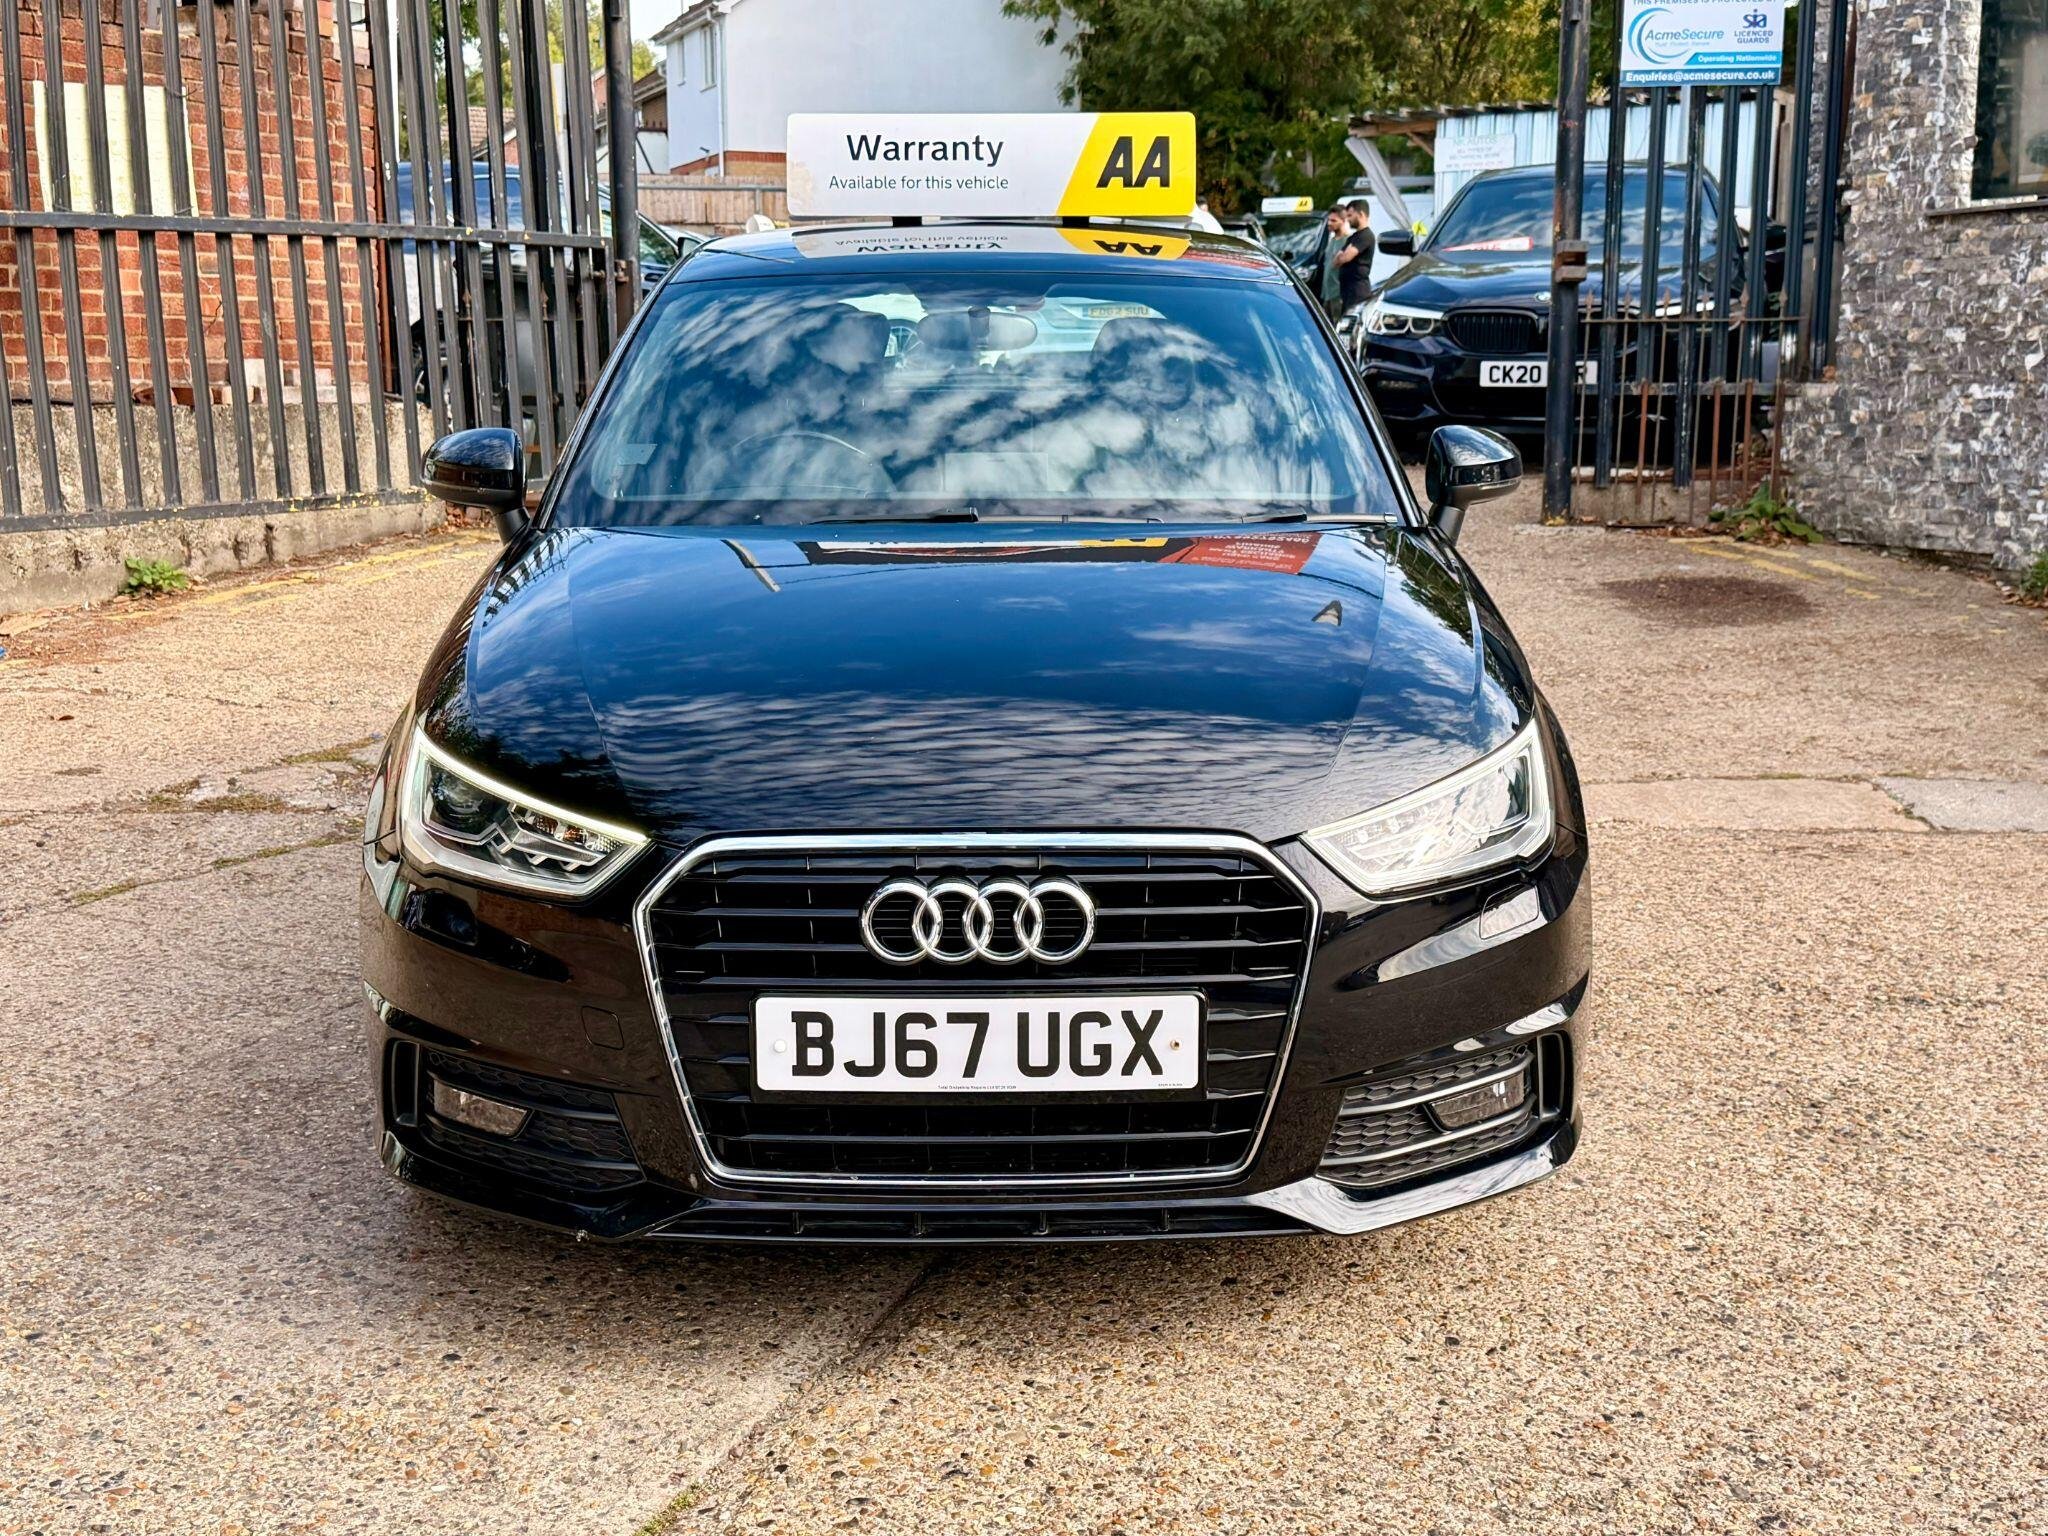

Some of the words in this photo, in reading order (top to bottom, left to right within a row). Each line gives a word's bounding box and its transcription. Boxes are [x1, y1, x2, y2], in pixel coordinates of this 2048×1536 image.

[1645, 28, 1725, 41] AcmeSecure
[1697, 54, 1735, 64] Operating
[1736, 53, 1777, 62] Nationwide
[1626, 71, 1776, 83] Enquiries@acmesecure.co.uk
[846, 134, 1004, 167] Warranty
[1095, 135, 1171, 188] AA
[828, 175, 897, 189] Available
[900, 175, 923, 189] for
[925, 175, 953, 189] this
[956, 175, 1009, 189] vehicle
[1489, 365, 1542, 384] CK20
[791, 1010, 990, 1079] BJ67
[1016, 1009, 1165, 1078] UGX
